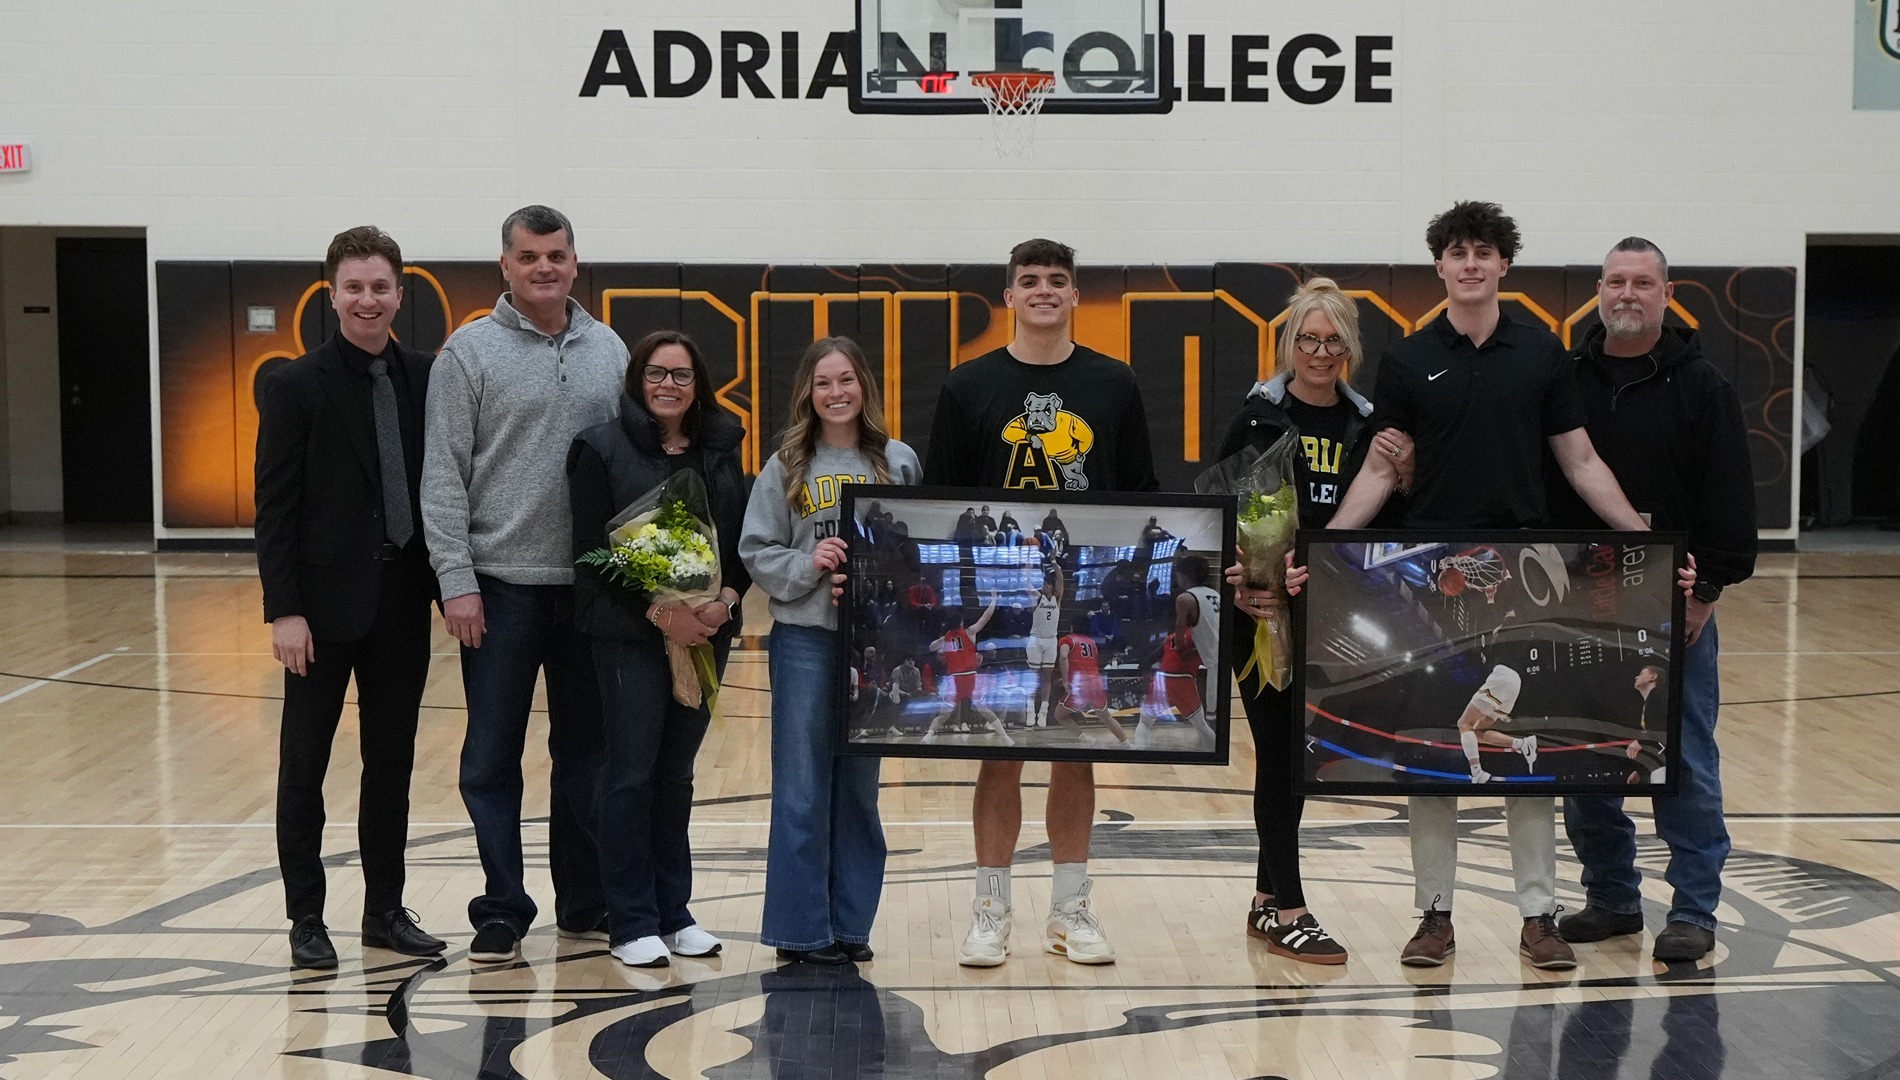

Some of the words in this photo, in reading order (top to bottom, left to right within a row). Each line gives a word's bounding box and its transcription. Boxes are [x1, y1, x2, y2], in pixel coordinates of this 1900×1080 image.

[579, 28, 947, 99] ADRIAN
[0, 144, 23, 169] XIT
[800, 473, 867, 520] AD
[814, 519, 842, 540] CO
[1046, 611, 1052, 620] 2
[950, 636, 963, 651] 11
[1080, 642, 1094, 659] 31
